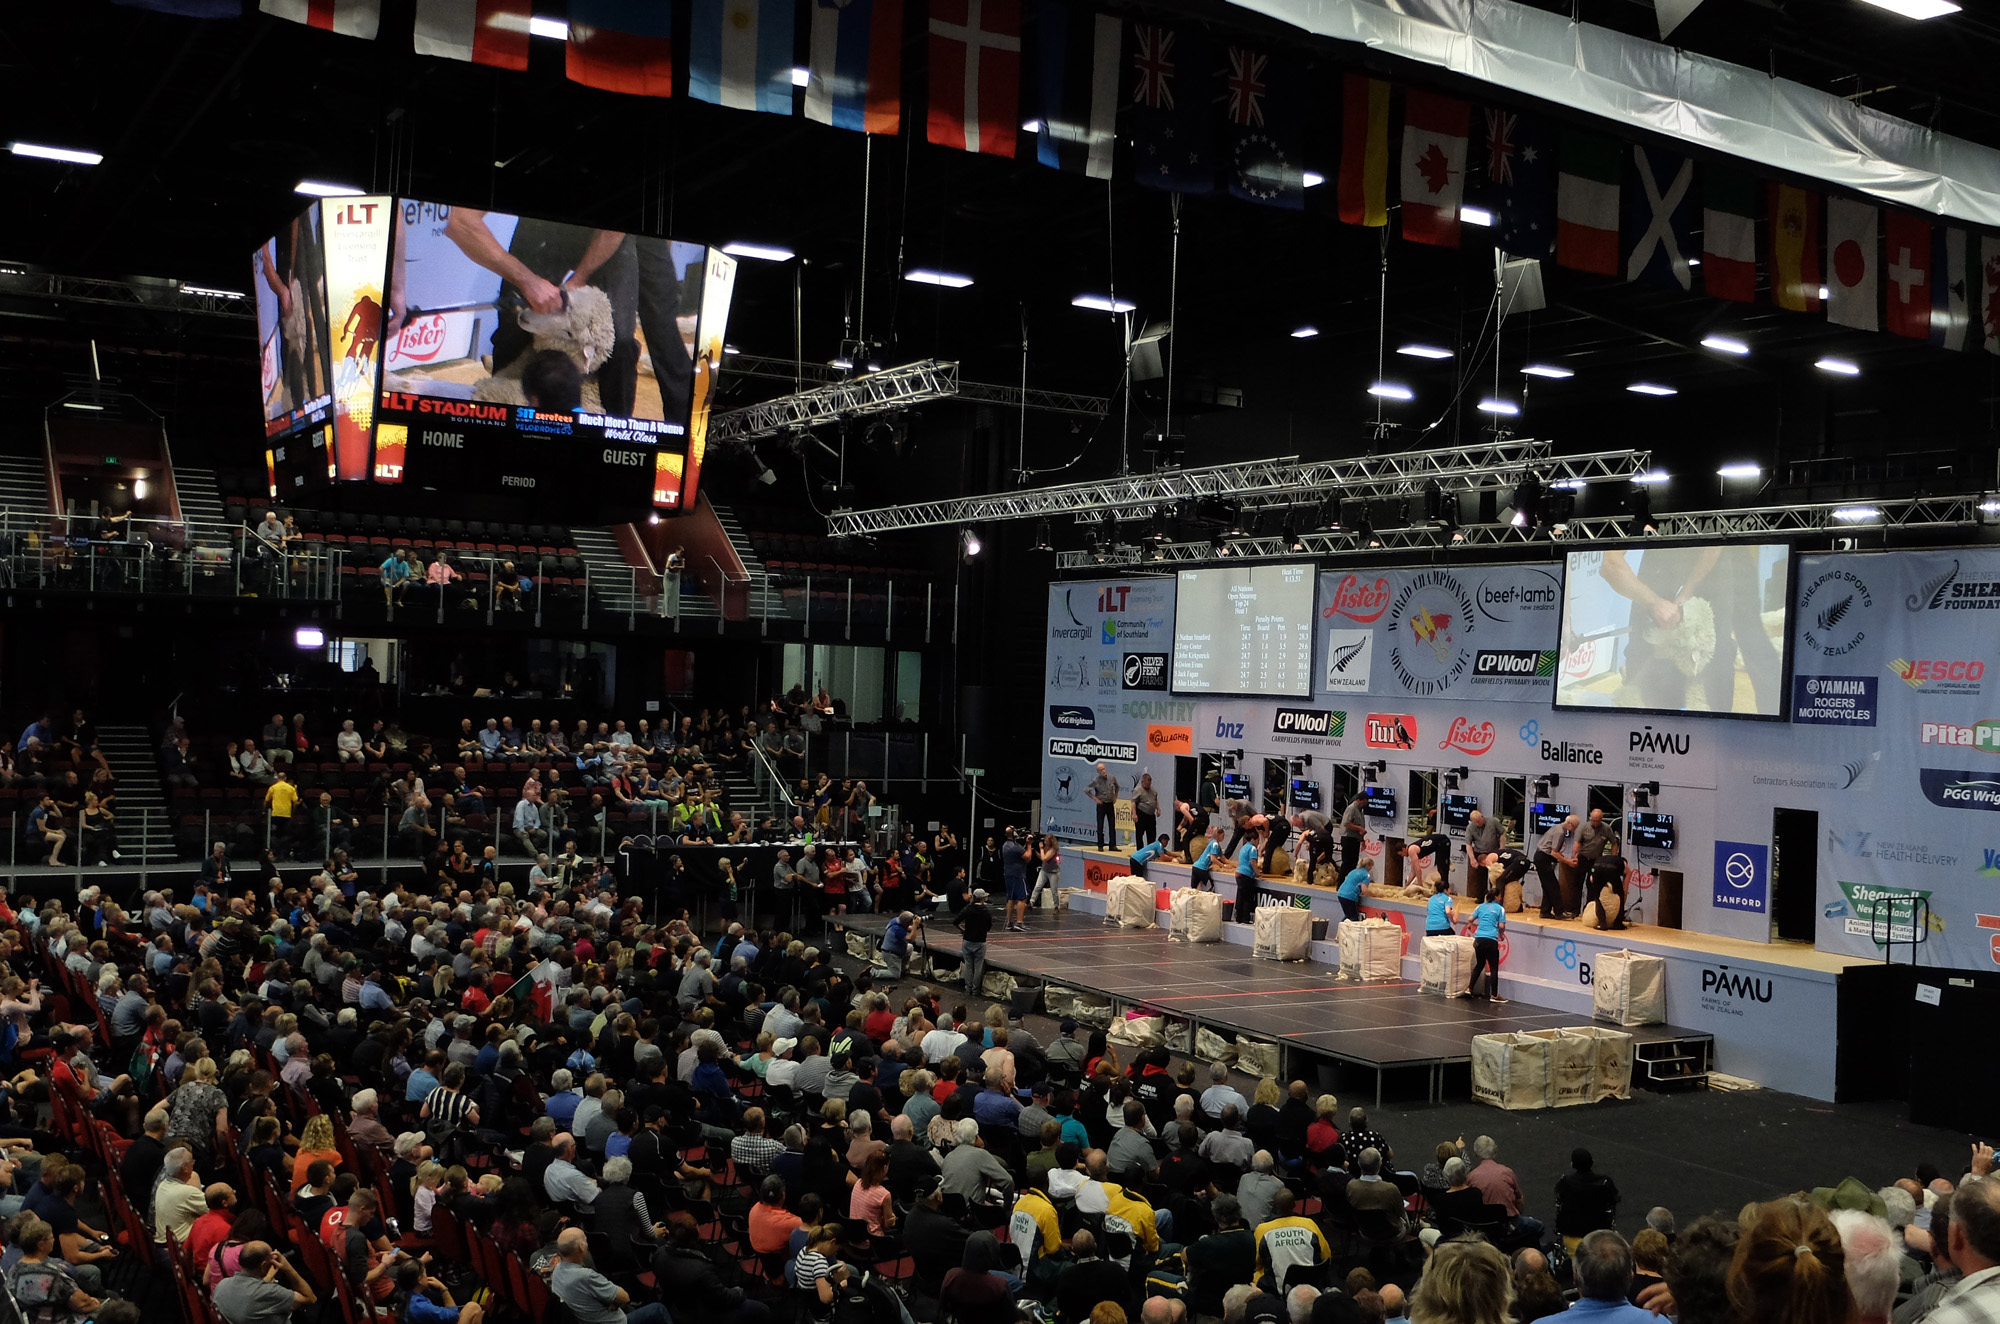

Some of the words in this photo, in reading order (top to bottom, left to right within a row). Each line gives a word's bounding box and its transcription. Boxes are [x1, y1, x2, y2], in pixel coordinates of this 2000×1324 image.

[450, 416, 507, 427] SOUTHLAND
[578, 413, 604, 426] Much
[604, 416, 628, 430] More
[628, 419, 650, 431] Than
[649, 421, 657, 432] A
[422, 430, 465, 449] HOME
[604, 428, 632, 441] World
[632, 430, 658, 444] Class
[603, 449, 647, 467] GUEST
[502, 475, 536, 488] PERIOD
[1960, 572, 1979, 580] THE
[1485, 586, 1556, 604] beef+lamb
[1801, 570, 1842, 608] SHEARING
[1843, 571, 1873, 608] SPORTS
[1227, 593, 1238, 601] Open
[1322, 574, 1391, 624] Lister
[1388, 585, 1413, 633] WORLD
[1412, 570, 1475, 634] CHAMPIONSHIPS
[1532, 604, 1555, 612] zealand
[1117, 620, 1147, 629] Community
[1297, 623, 1309, 631] Total
[1051, 626, 1093, 640] Invercargill
[1117, 630, 1122, 638] of
[1122, 630, 1149, 638] Southland
[1803, 631, 1822, 651] NEW
[1823, 630, 1865, 656] ZEALAND
[1142, 656, 1164, 667] SILVER
[1142, 667, 1160, 676] FERN
[1389, 647, 1434, 696] SOUTHLAND
[1436, 676, 1451, 692] NZ
[1450, 648, 1471, 682] 2017
[1900, 660, 1985, 681] JESCO
[1142, 676, 1164, 686] FARMS
[1329, 678, 1342, 686] NEW
[1342, 678, 1366, 686] ZEALAND
[1470, 677, 1503, 685] CARRFIELDS
[1503, 678, 1531, 686] PRIMARY
[1820, 680, 1865, 695] YAMAHA
[1814, 697, 1856, 708] ROGERS
[1130, 700, 1197, 722] COUNTRY
[1798, 707, 1871, 720] MOTORCYCLES
[1058, 716, 1069, 724] PGG
[1069, 717, 1094, 727] Wrightson
[1215, 715, 1245, 740] bnz
[1368, 719, 1395, 743] Tui
[1438, 716, 1496, 756] Lister
[1153, 733, 1189, 744] GALLAGHER
[1271, 736, 1301, 744] CARRFIELDS
[1300, 737, 1325, 746] PRIMARY
[1325, 739, 1342, 747] WOOL
[1629, 725, 1691, 755] PĀMU
[1052, 742, 1074, 754] ACTO
[1075, 743, 1135, 759] AGRICULTURE
[1541, 740, 1603, 764] Ballance
[1752, 775, 1789, 786] Contractors
[1789, 777, 1826, 789] Association
[1827, 781, 1838, 790] Inc
[1383, 788, 1395, 796] 29.3
[1943, 788, 1971, 801] PGG
[1464, 796, 1477, 804] 30.5
[1555, 805, 1570, 813] 33.6
[1656, 814, 1673, 824] 37.1
[1643, 825, 1655, 833] Lloyd
[1667, 840, 1673, 849] 7
[1876, 841, 1896, 849] NEW
[1896, 842, 1928, 852] ZEALAND
[1876, 850, 1912, 862] HEALTH
[1915, 852, 1959, 866] DELIVERY
[1716, 894, 1762, 908] SANFORD
[1851, 885, 1920, 906] Shearwell
[1848, 919, 1872, 928] Animal
[1702, 965, 1773, 1004] PĀMU
[1701, 996, 1721, 1005] FARMS
[1722, 999, 1731, 1007] OF
[1701, 1003, 1715, 1011] NEW
[1716, 1005, 1744, 1017] ZEALAND
[1274, 1229, 1304, 1240] SOUTH
[1274, 1237, 1307, 1248] AFRICA
